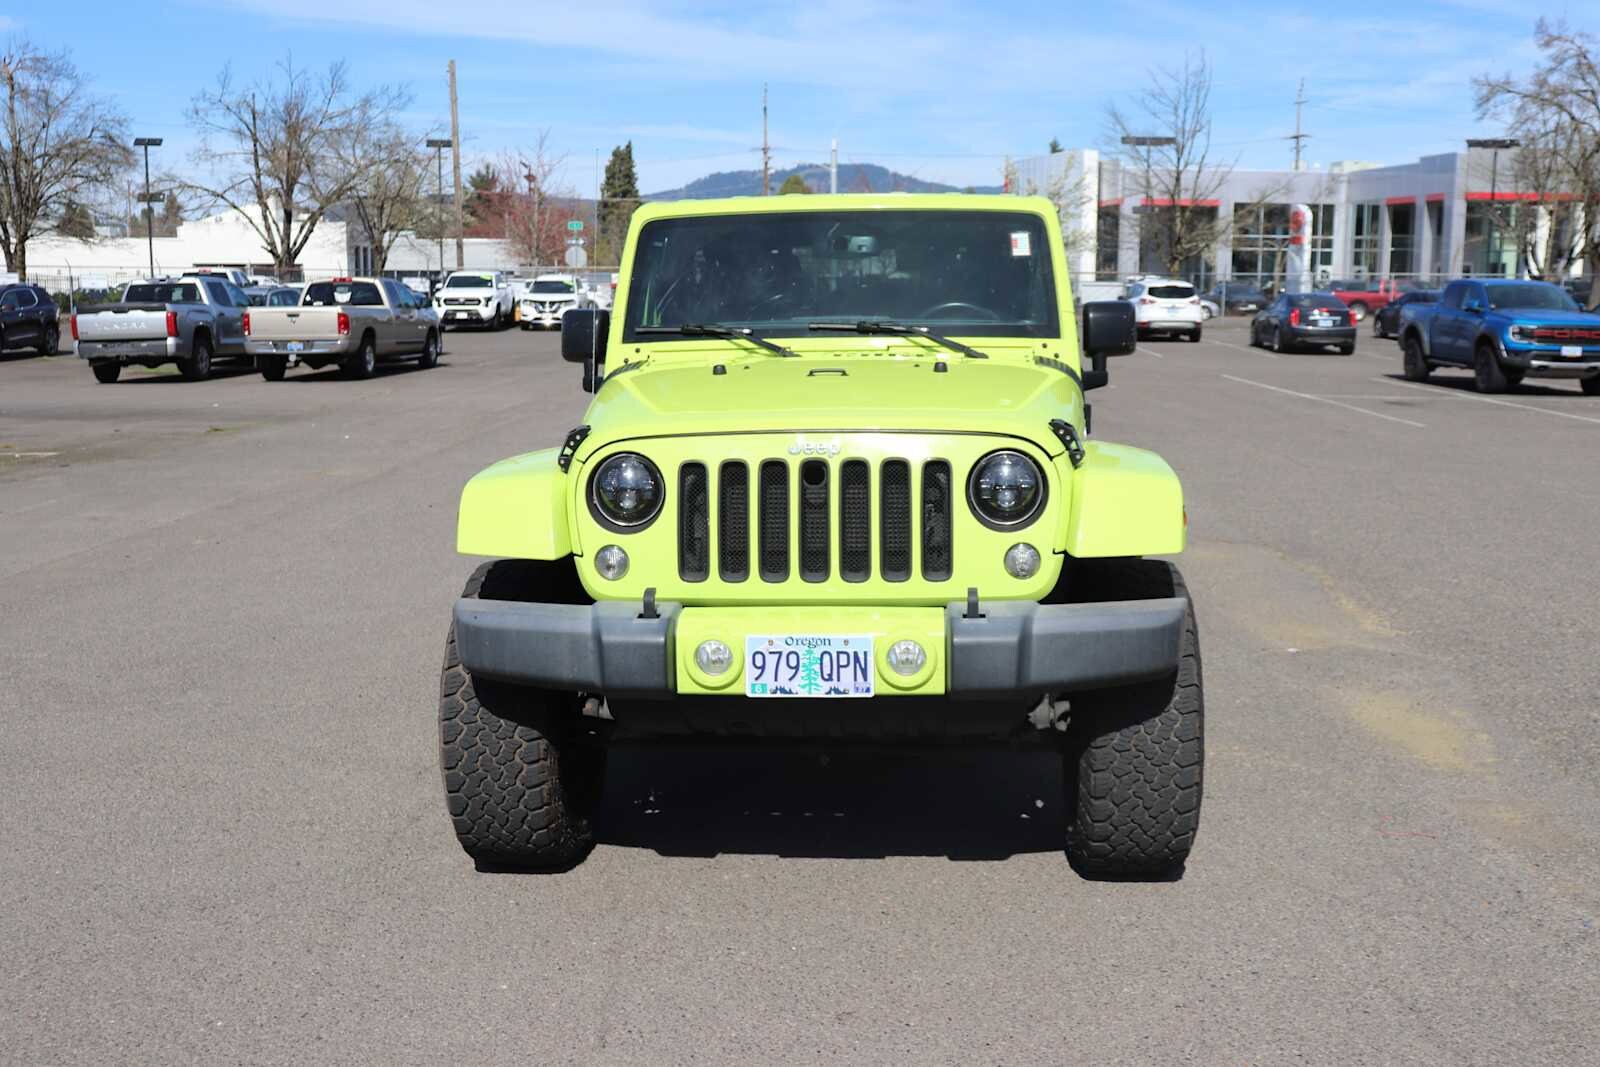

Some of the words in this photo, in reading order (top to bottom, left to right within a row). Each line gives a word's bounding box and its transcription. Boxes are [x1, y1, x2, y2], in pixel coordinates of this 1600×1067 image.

[787, 439, 841, 459] Jeep
[785, 636, 832, 649] Oregon
[752, 650, 800, 682] 979
[819, 650, 868, 682] QPN
